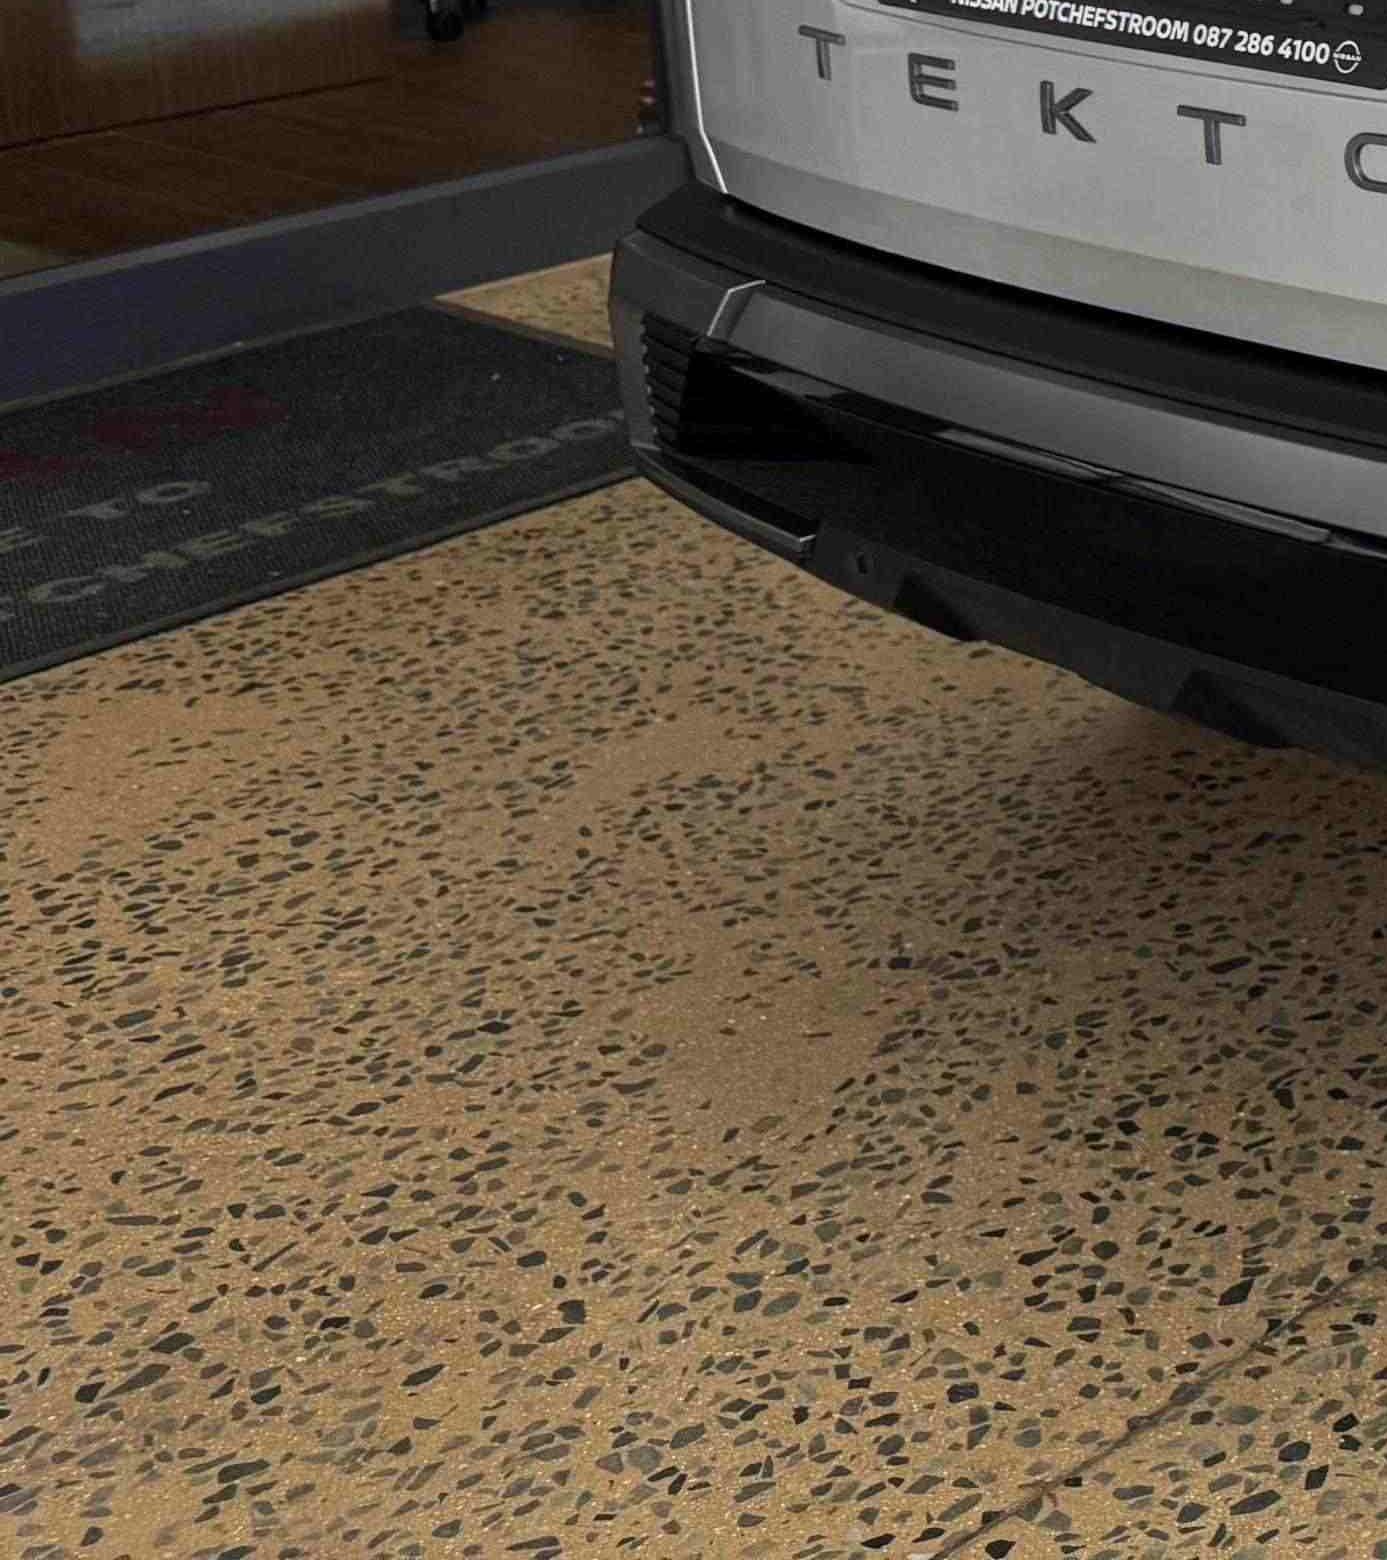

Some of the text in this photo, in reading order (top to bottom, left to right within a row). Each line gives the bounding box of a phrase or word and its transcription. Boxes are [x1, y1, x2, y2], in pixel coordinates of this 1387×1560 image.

[1193, 24, 1232, 49] 087
[1234, 30, 1275, 56] 286
[1278, 38, 1331, 64] 4100
